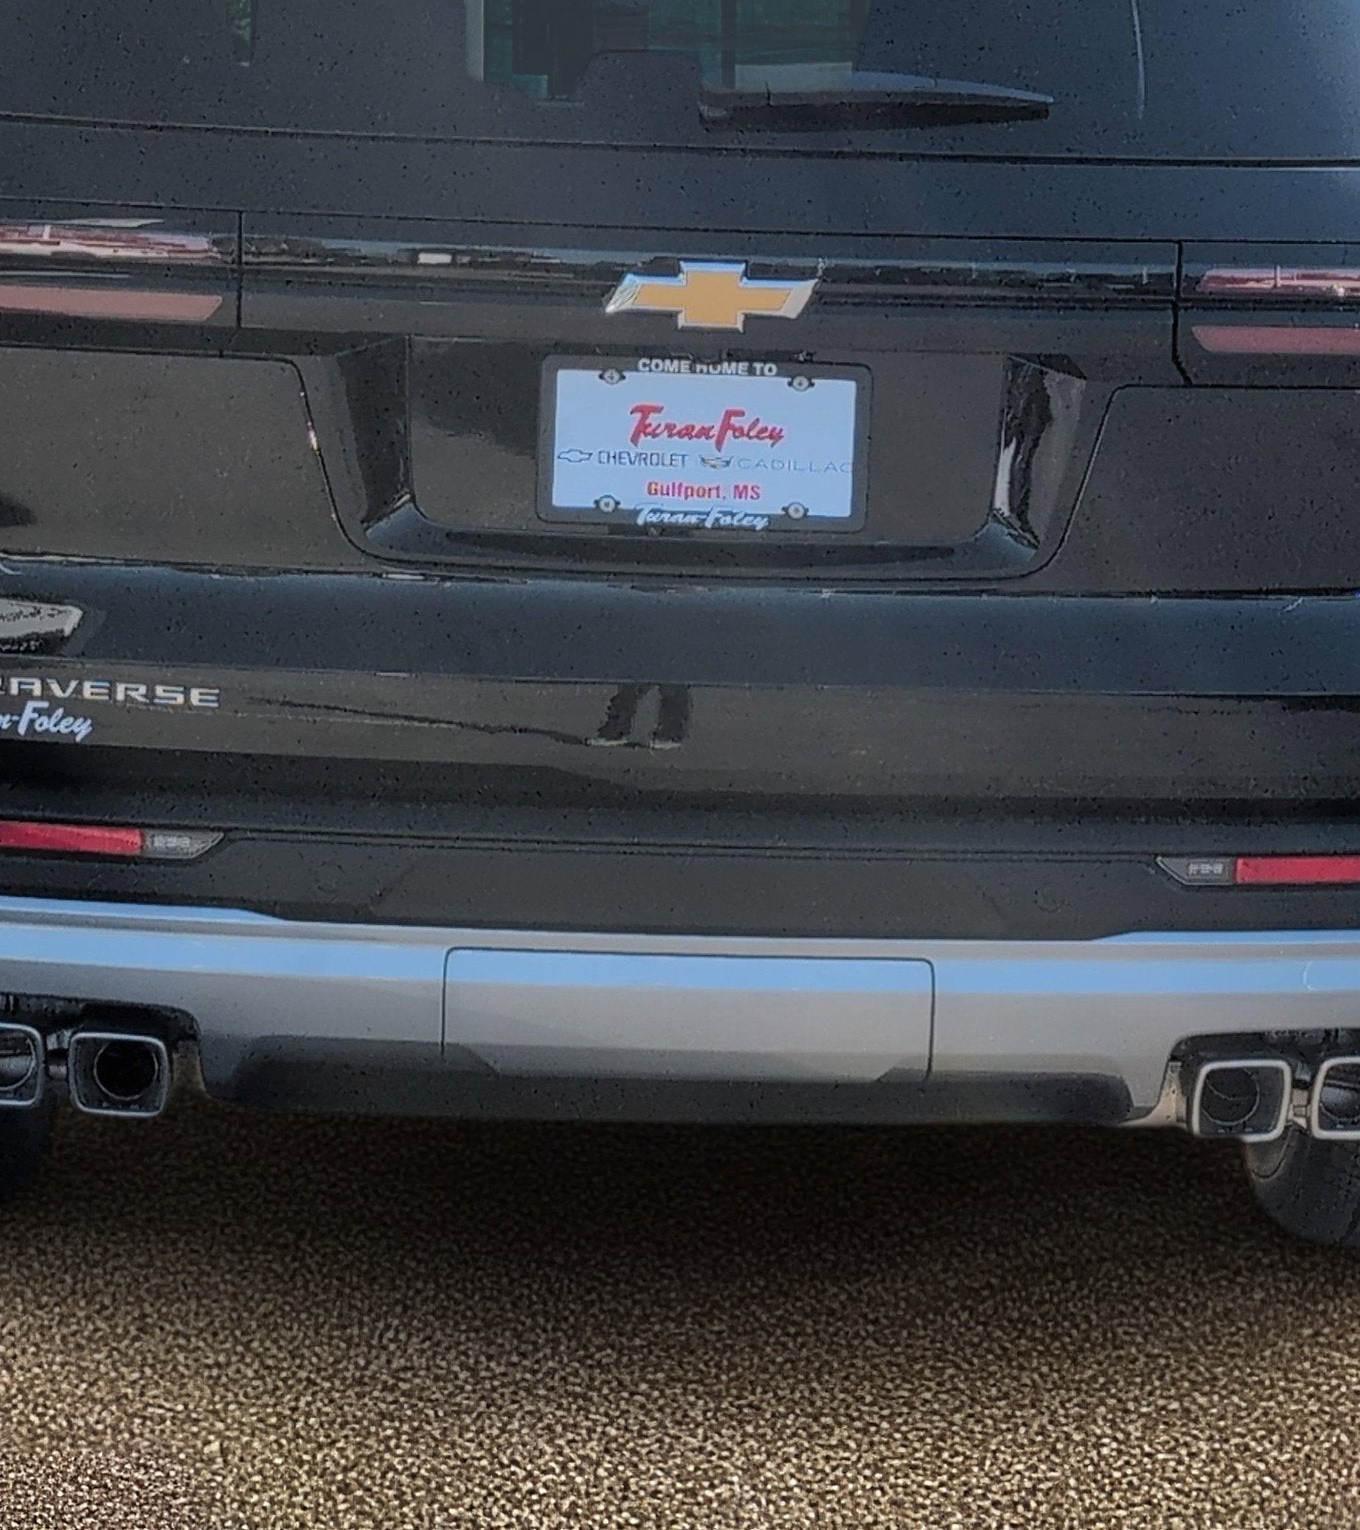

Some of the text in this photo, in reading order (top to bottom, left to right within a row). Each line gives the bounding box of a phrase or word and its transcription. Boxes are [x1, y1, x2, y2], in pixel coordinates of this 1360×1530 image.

[638, 358, 691, 373] COME
[753, 362, 778, 376] TO
[598, 451, 853, 473] CHEVROLET CADILLAC
[647, 481, 762, 501] Gulfport, MS
